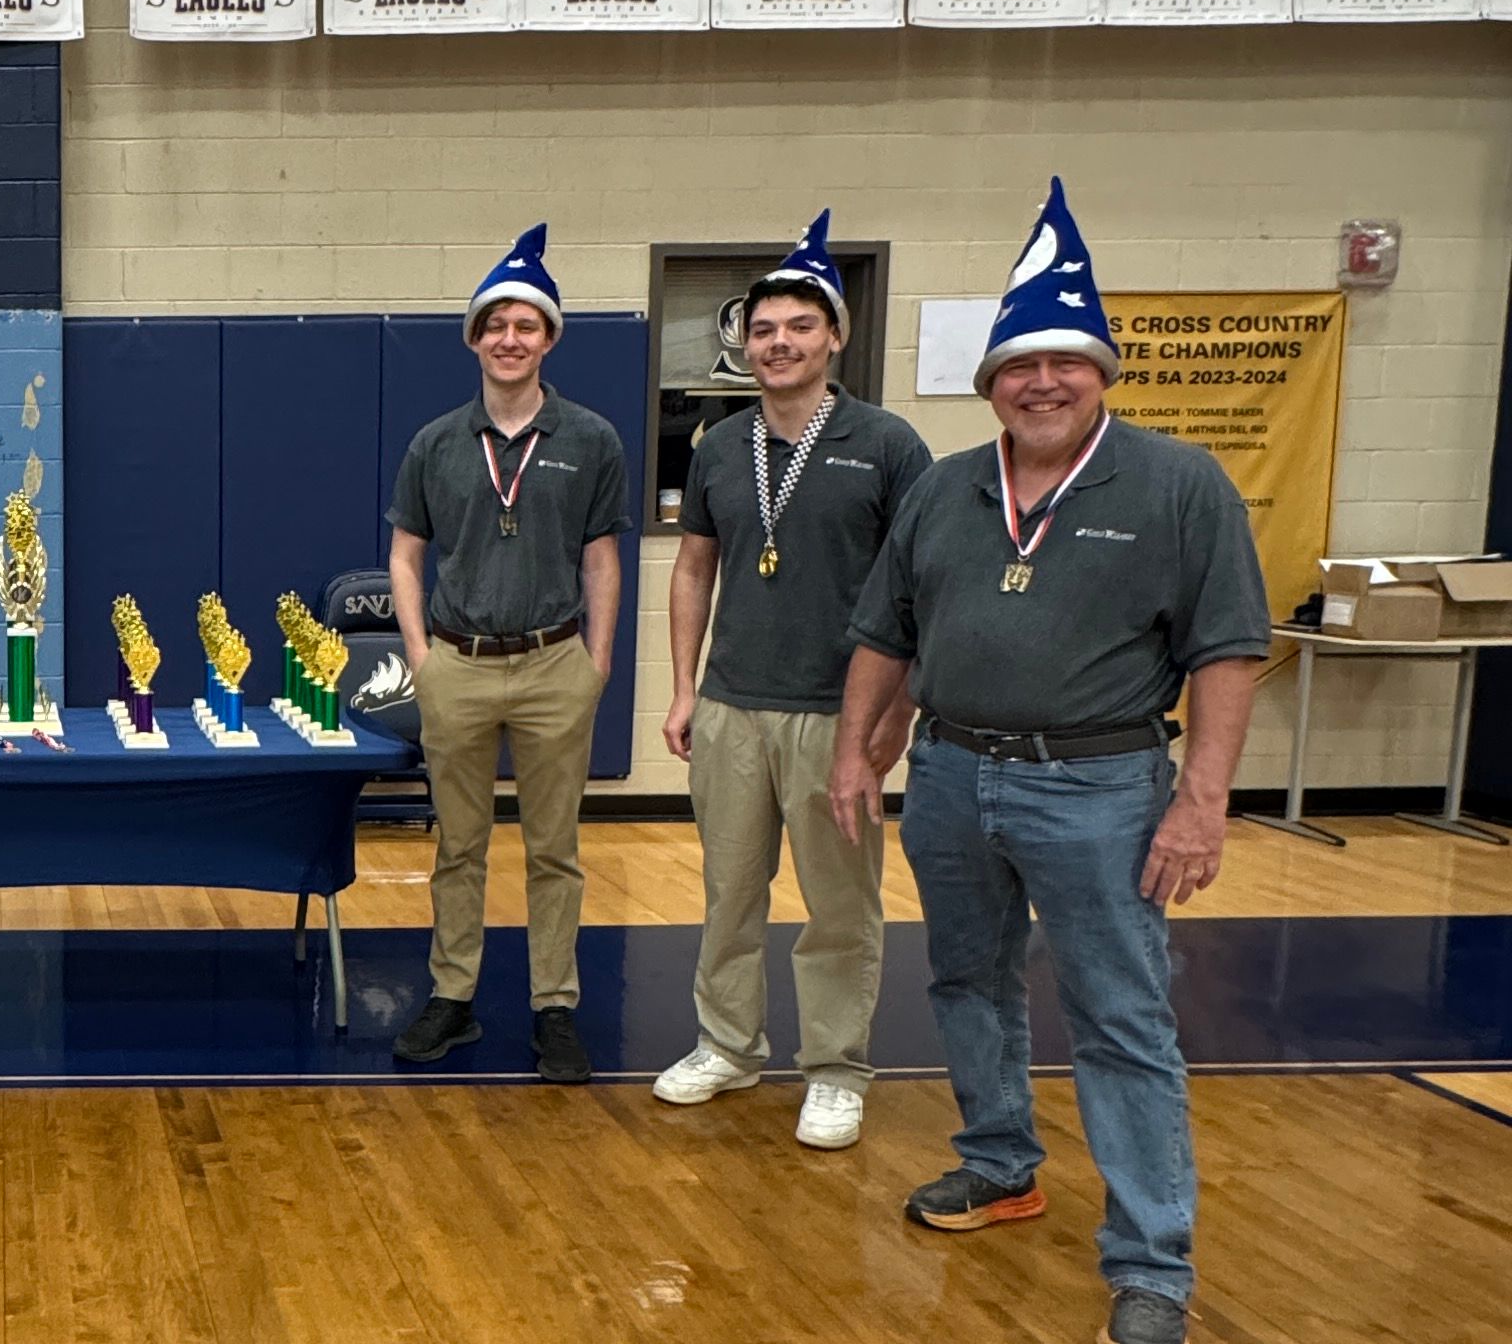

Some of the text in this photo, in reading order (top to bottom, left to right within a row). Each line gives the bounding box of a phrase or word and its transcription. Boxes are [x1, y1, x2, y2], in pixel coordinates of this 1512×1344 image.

[1131, 315, 1211, 334] CROSS
[1218, 314, 1333, 334] COUNTRY
[1159, 341, 1302, 360] CHAMPIONS
[1156, 370, 1182, 385] 5A
[1188, 369, 1288, 385] 2023-2024
